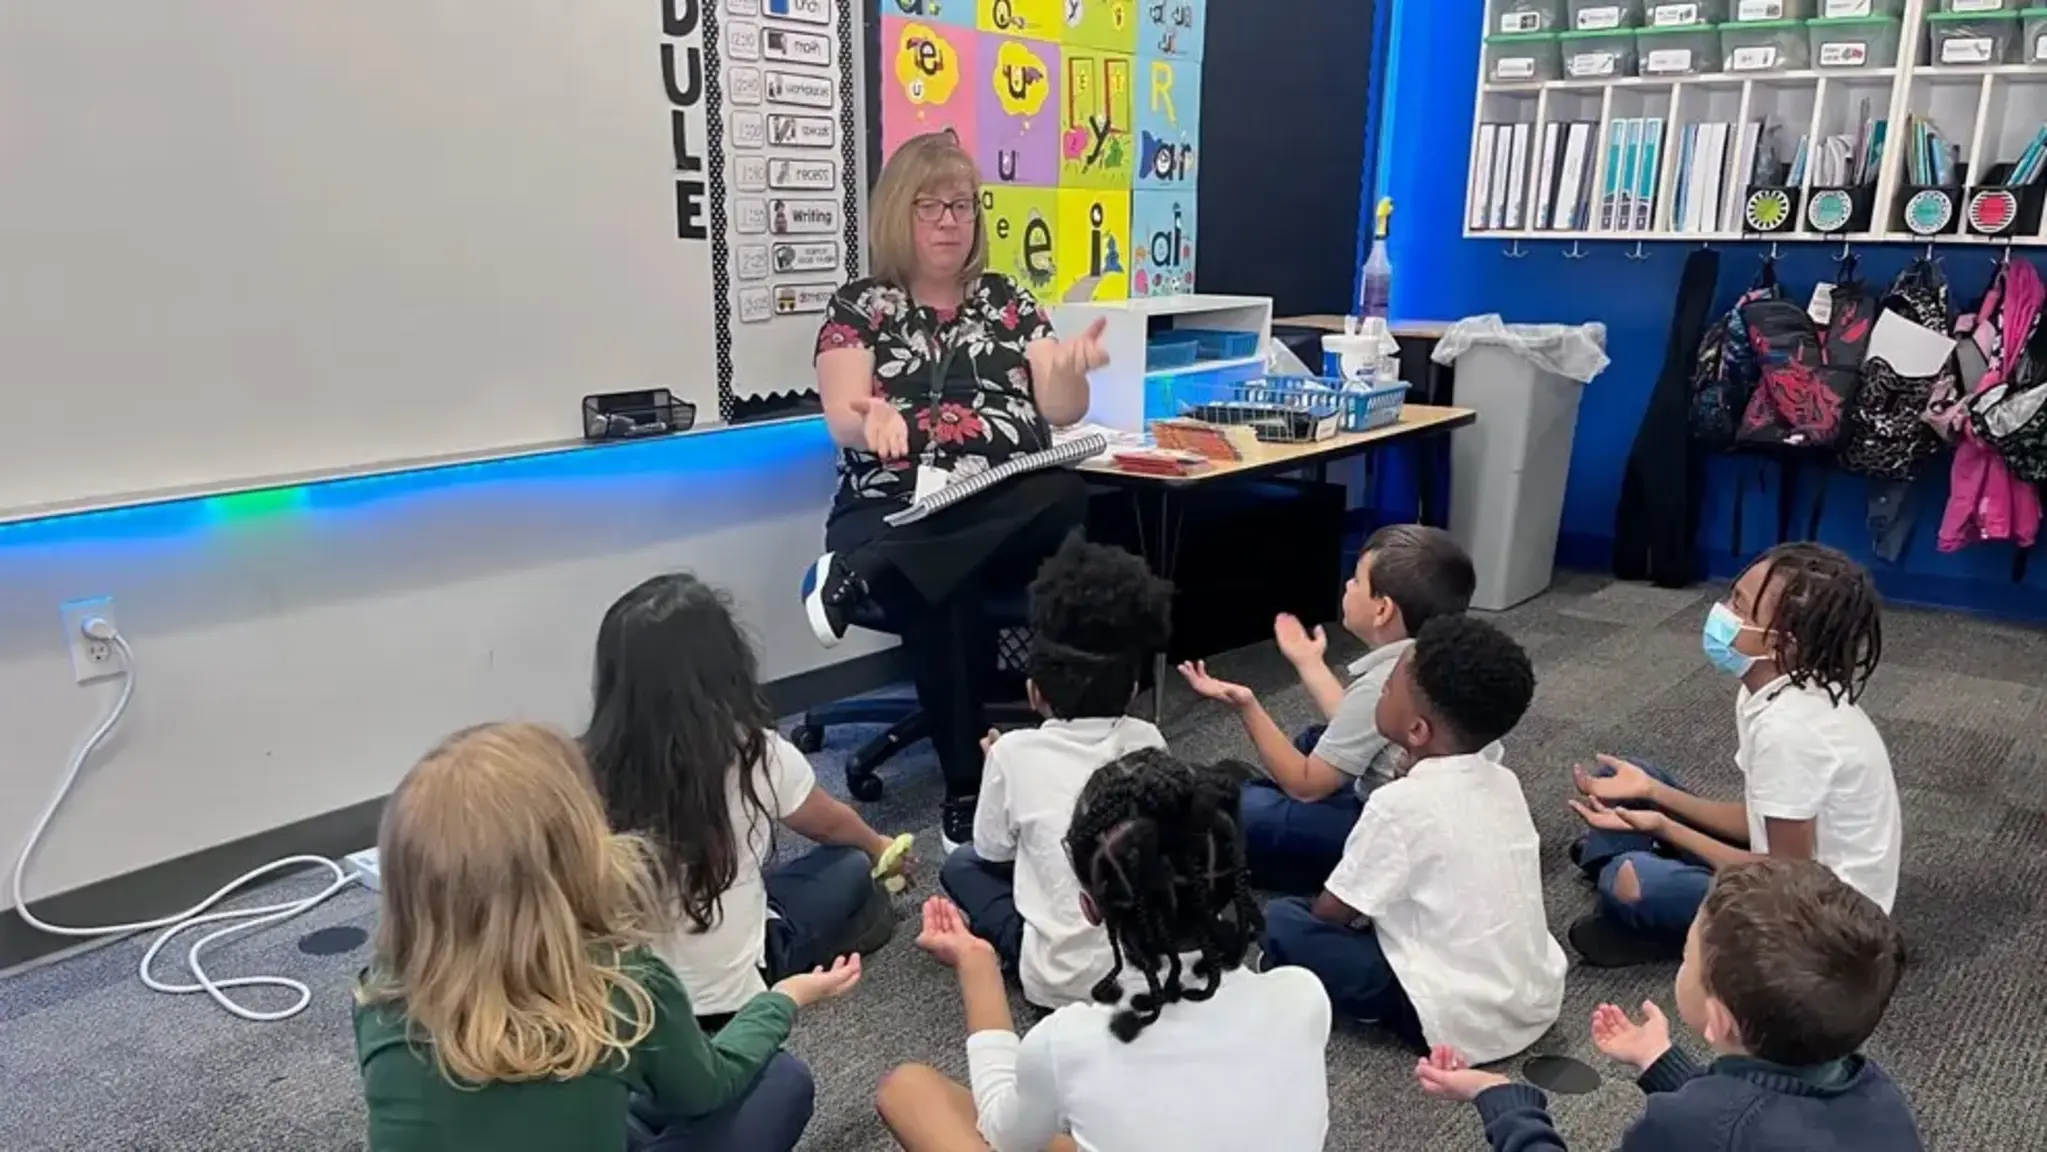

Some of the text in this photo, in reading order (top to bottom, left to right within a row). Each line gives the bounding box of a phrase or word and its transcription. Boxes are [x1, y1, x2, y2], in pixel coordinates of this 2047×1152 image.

[919, 40, 937, 75] e
[796, 168, 829, 181] recess
[998, 149, 1016, 182] u
[1153, 141, 1193, 181] ar
[792, 208, 832, 226] Writing
[983, 191, 994, 210] a
[996, 218, 1010, 239] e
[1090, 202, 1104, 277] i
[1023, 217, 1053, 280] e
